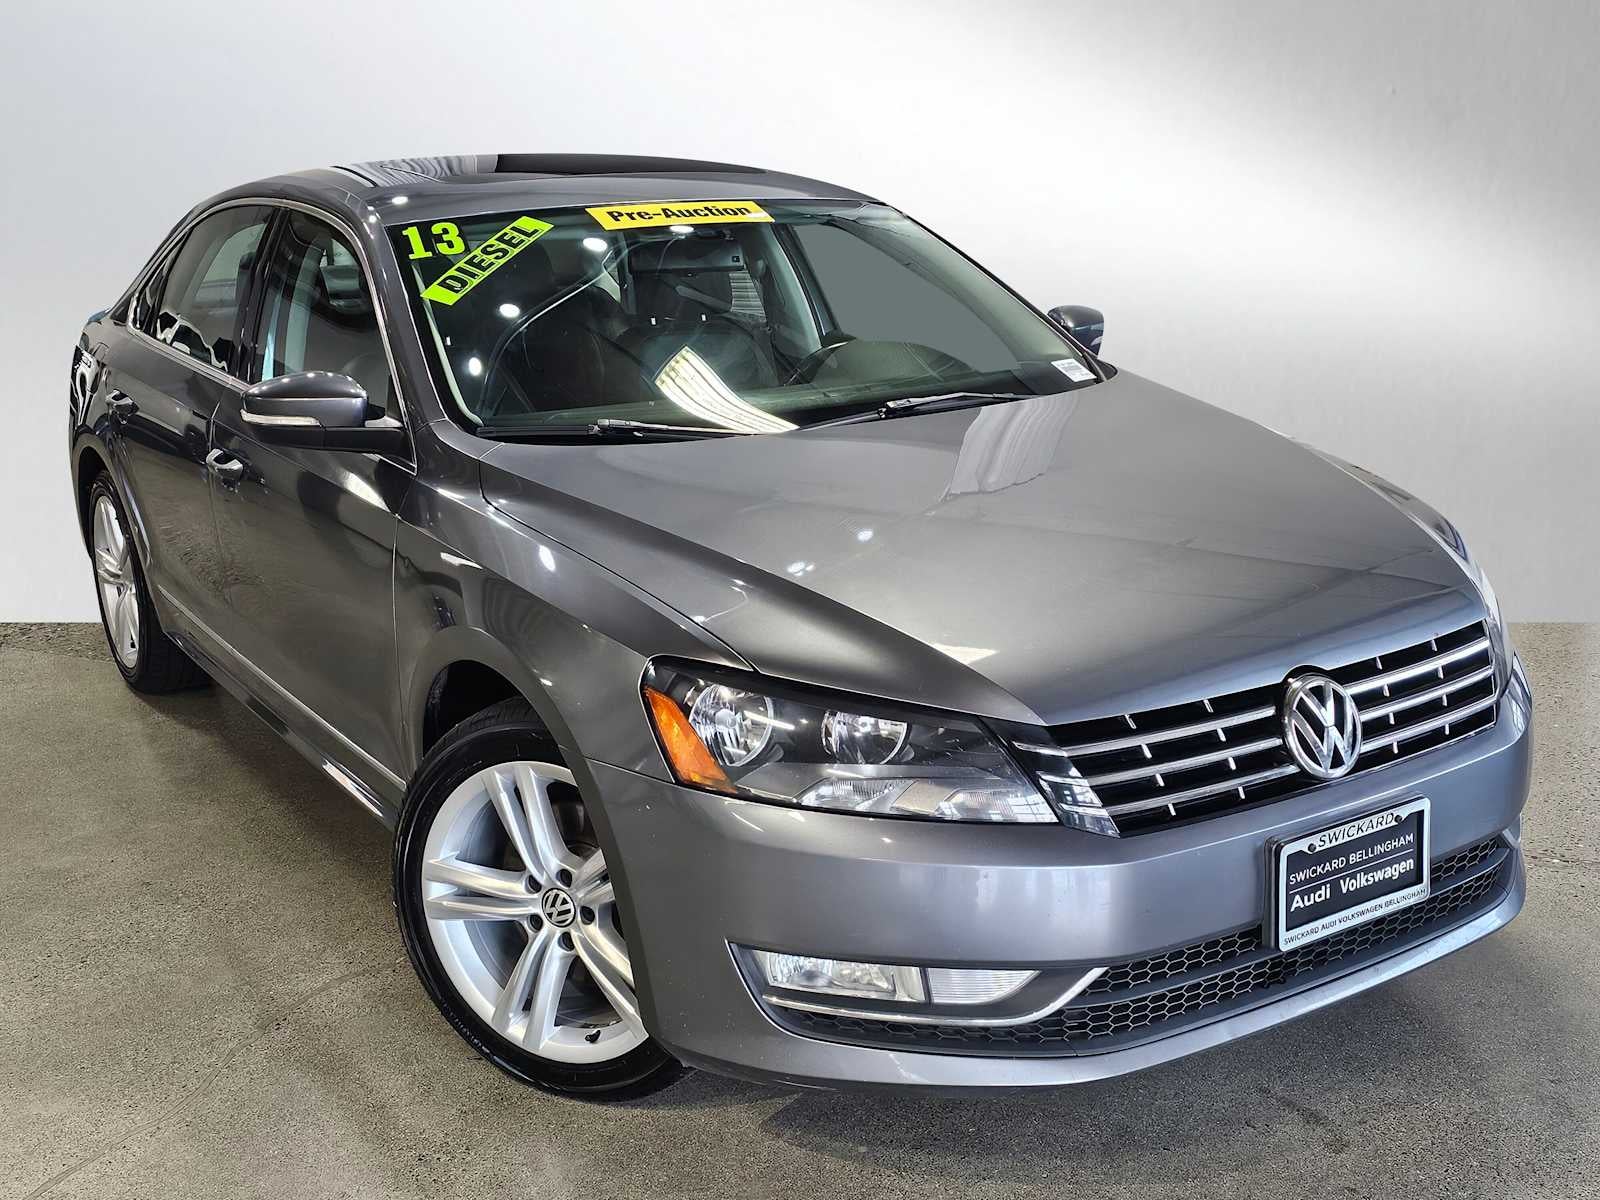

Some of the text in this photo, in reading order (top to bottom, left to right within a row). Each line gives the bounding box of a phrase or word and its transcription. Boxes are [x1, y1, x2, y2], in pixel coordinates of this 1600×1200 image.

[606, 205, 751, 222] Pre-Auction
[402, 222, 466, 260] 13
[437, 225, 540, 294] DIESEL
[1318, 812, 1395, 849] SWICKARD
[1289, 833, 1414, 885] SWICKARD BELLINGHAM
[1290, 858, 1414, 912] Audi Volkswagen
[1283, 888, 1426, 945] SWICKARD AUDI VOLKSWAGEN BELLINGHAM
